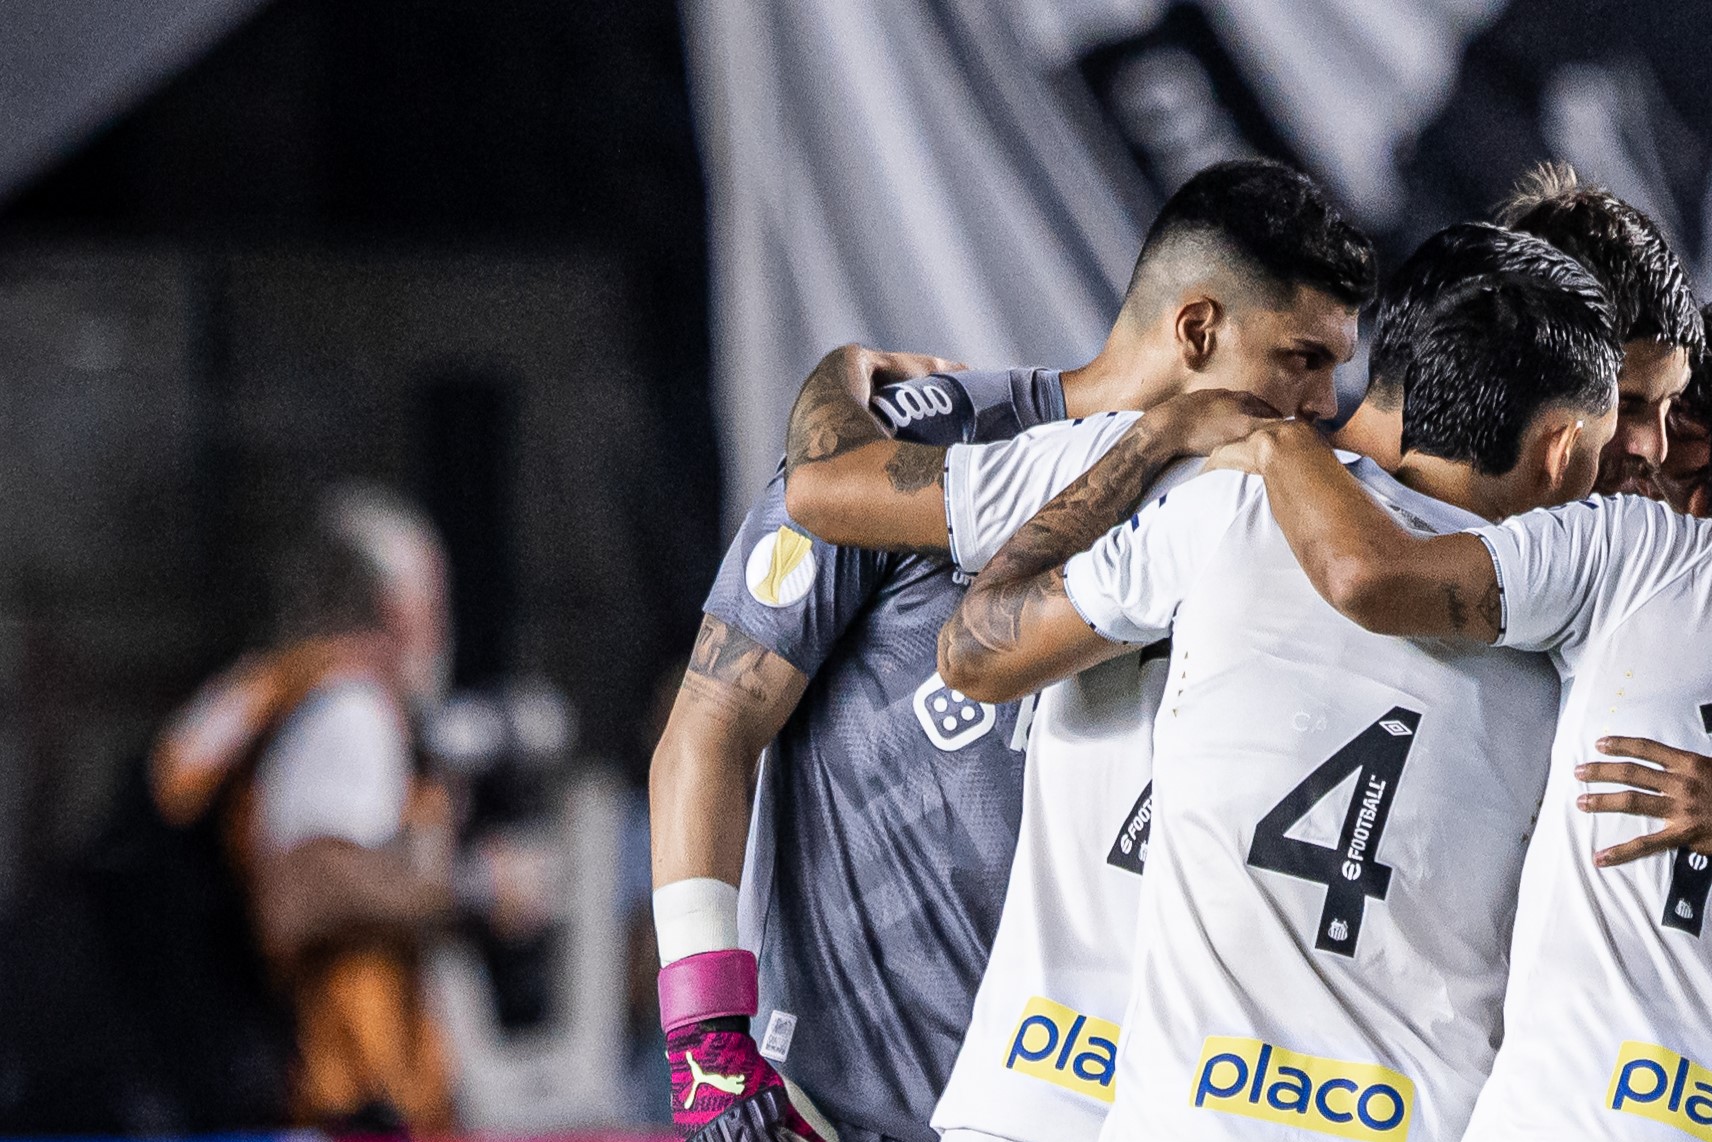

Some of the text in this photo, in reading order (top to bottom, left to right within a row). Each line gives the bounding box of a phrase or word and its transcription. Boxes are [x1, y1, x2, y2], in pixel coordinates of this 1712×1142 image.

[1247, 705, 1422, 958] 4
[1006, 1015, 1118, 1086] pla
[1195, 1043, 1404, 1131] placo
